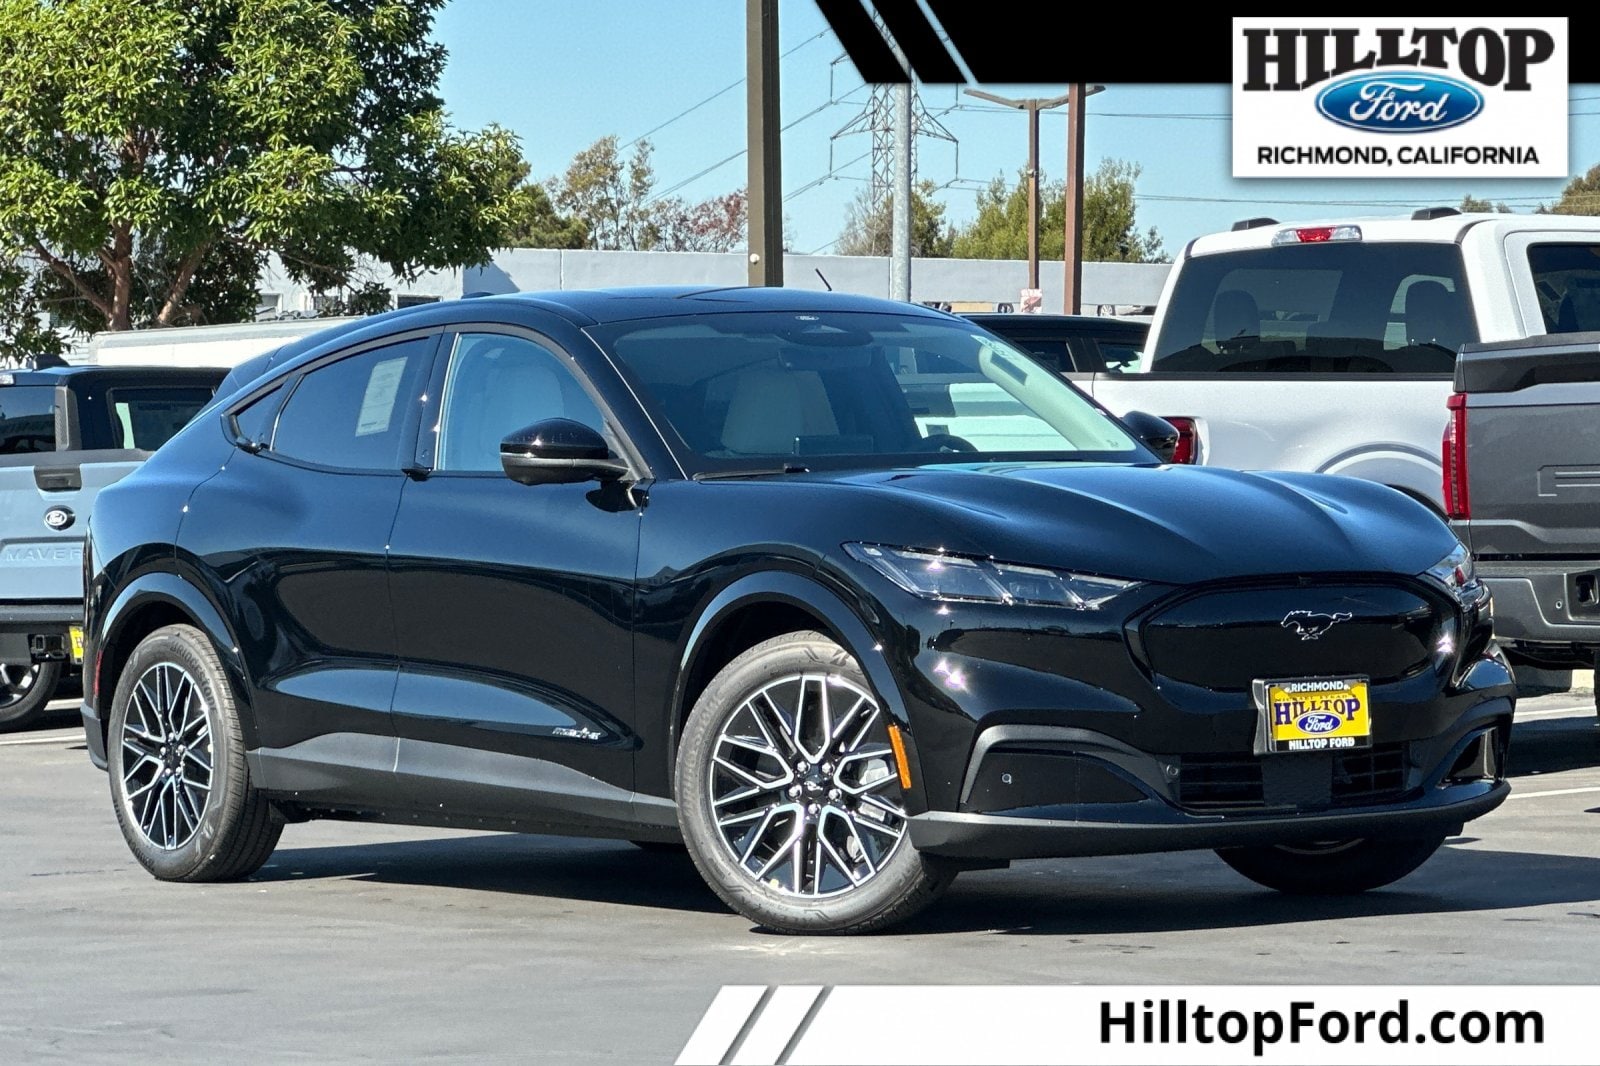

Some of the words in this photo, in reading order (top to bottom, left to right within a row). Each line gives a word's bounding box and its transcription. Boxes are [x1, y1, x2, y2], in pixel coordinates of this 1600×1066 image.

[1291, 681, 1344, 692] RICHMOND
[1274, 697, 1360, 725] HILLTOP
[1304, 714, 1334, 731] Ford
[1288, 738, 1327, 750] HILLTOP
[1329, 737, 1355, 748] FORD
